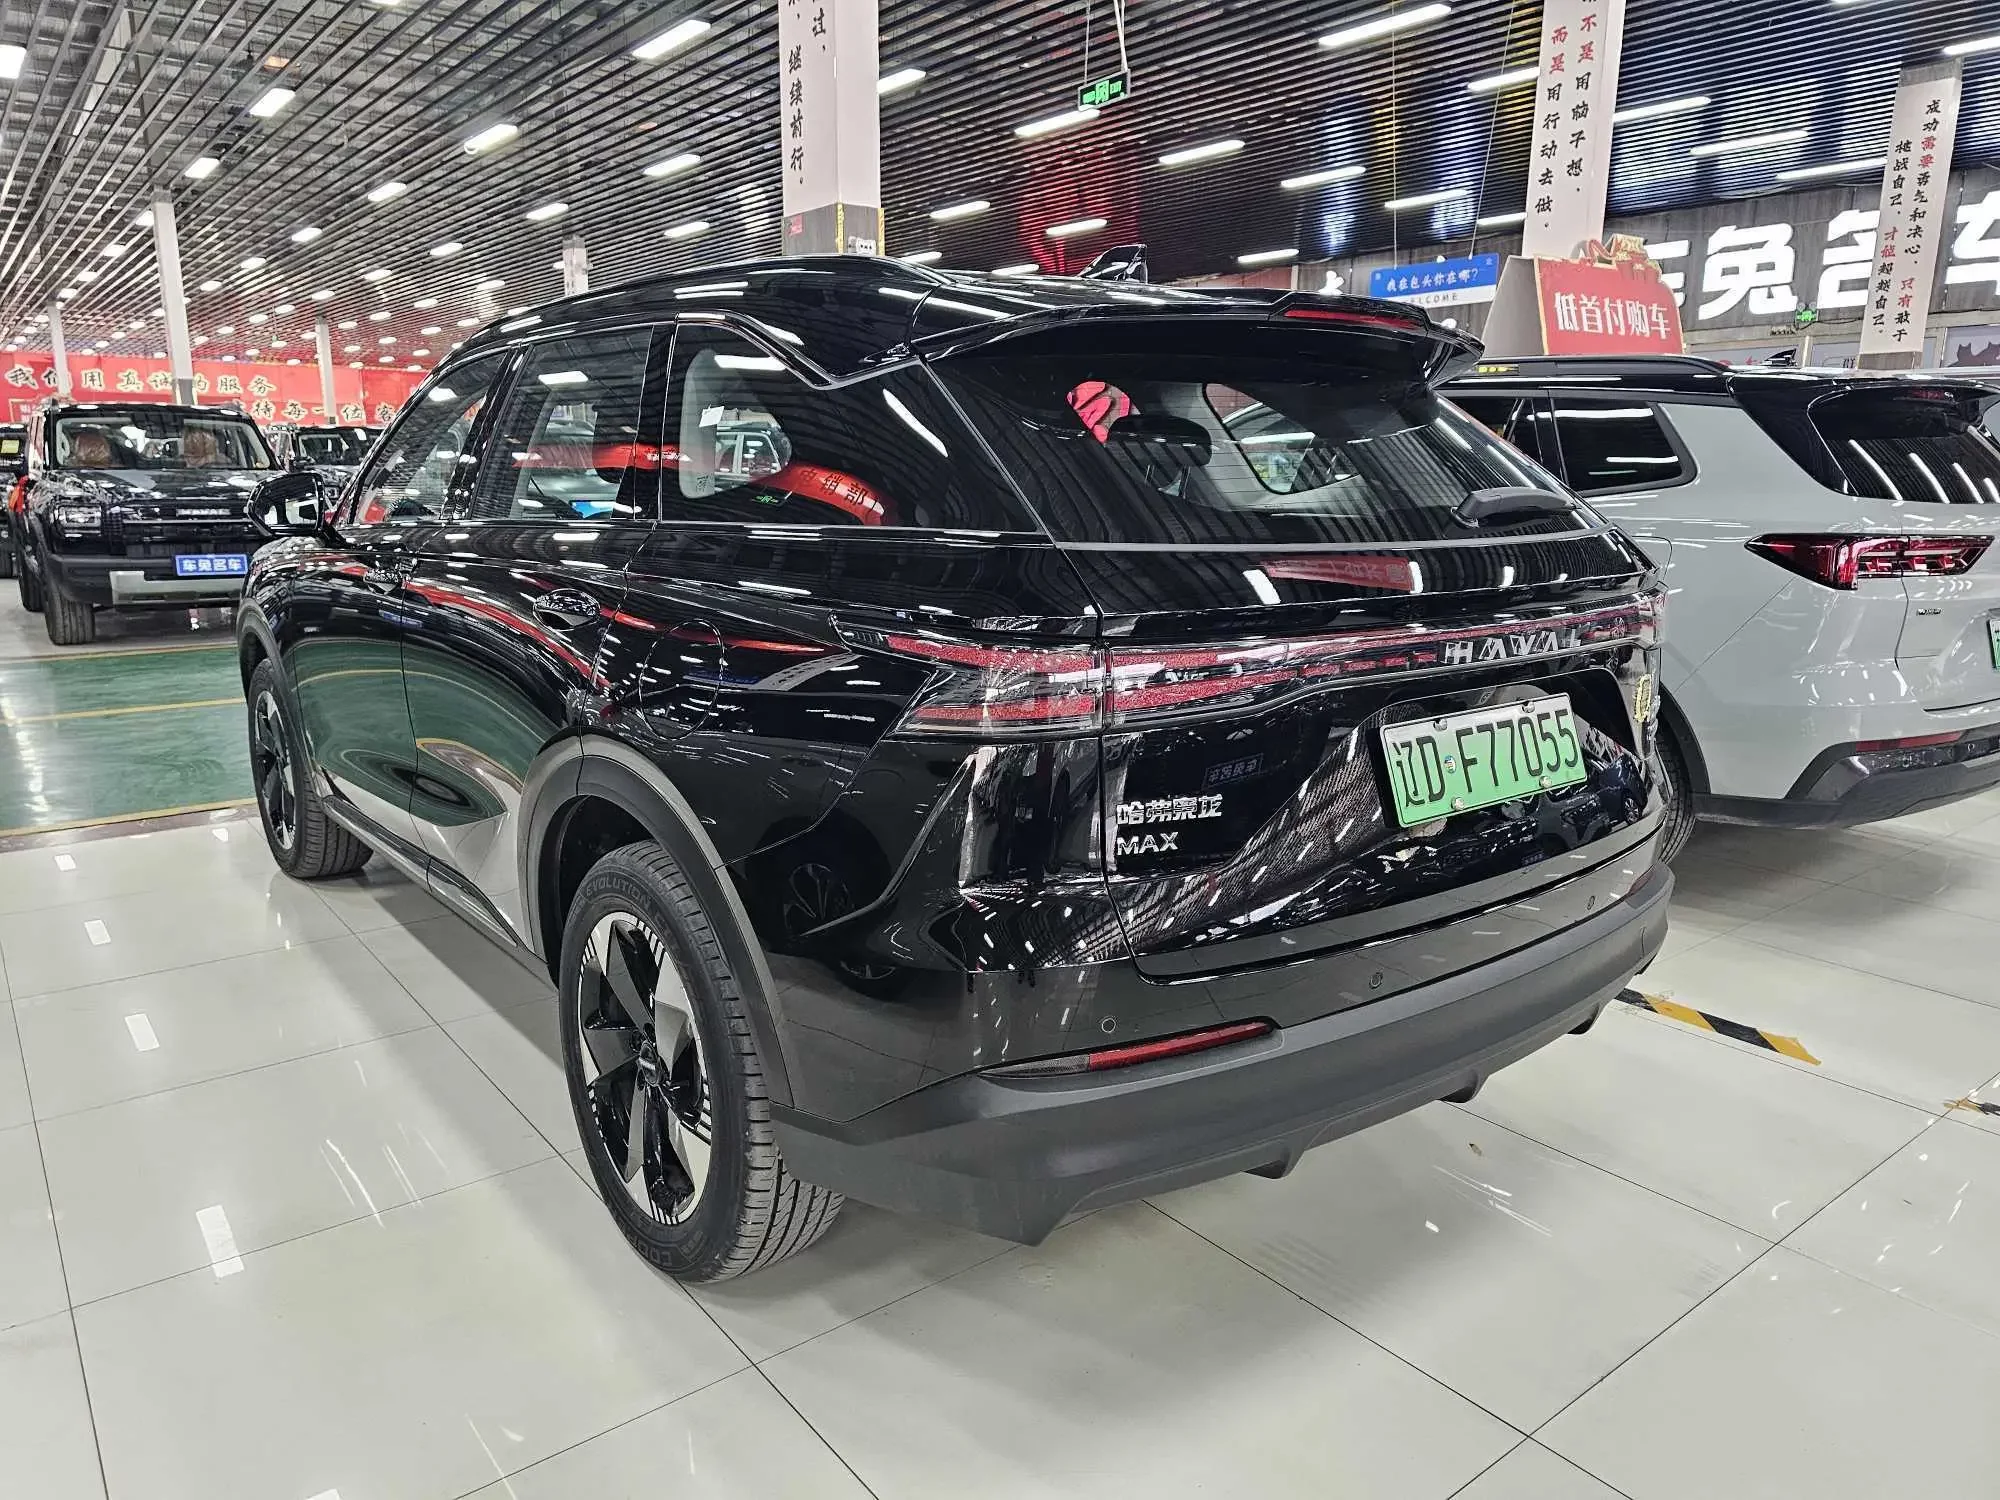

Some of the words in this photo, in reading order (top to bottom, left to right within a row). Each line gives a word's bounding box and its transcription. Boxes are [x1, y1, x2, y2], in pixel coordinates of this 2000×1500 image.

[1554, 291, 1671, 339] 低首付购车
[1444, 629, 1582, 664] HAVAL
[1116, 793, 1223, 825] 哈弗枭龙
[1116, 832, 1179, 855] MAX
[586, 876, 652, 911] EVOLUTION
